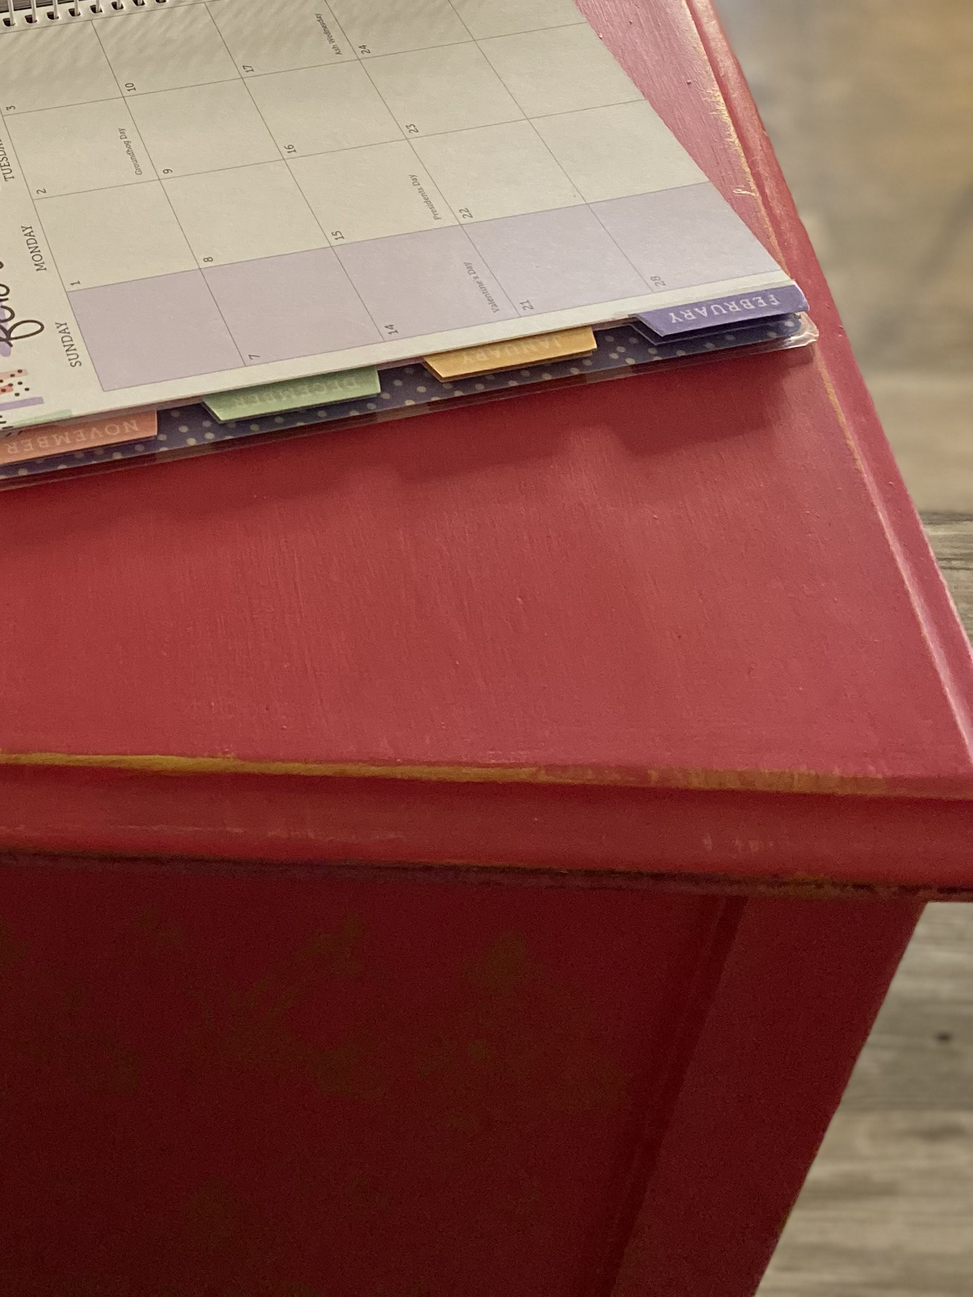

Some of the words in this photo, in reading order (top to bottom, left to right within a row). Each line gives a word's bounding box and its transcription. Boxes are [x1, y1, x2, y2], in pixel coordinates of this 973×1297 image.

[358, 43, 372, 56] 24
[241, 63, 255, 74] 17
[124, 82, 138, 93] 10
[5, 104, 16, 112] 3
[405, 122, 419, 134] 23
[283, 143, 298, 155] 16
[161, 167, 173, 175] 9
[35, 187, 47, 195] 2
[458, 206, 474, 220] 22
[330, 229, 346, 242] 15
[20, 224, 48, 272] MONDAY
[202, 256, 214, 264] 8
[69, 279, 81, 287] 1
[649, 274, 667, 288] 28
[519, 298, 535, 312] 21
[668, 292, 781, 324] FEBRUARY
[383, 322, 399, 336] 14
[54, 321, 83, 368] SUNDAY
[461, 334, 563, 365] JANUARY
[247, 352, 261, 361] 7
[231, 375, 359, 408] DECEMBER
[6, 419, 140, 455] NOVEMBER
